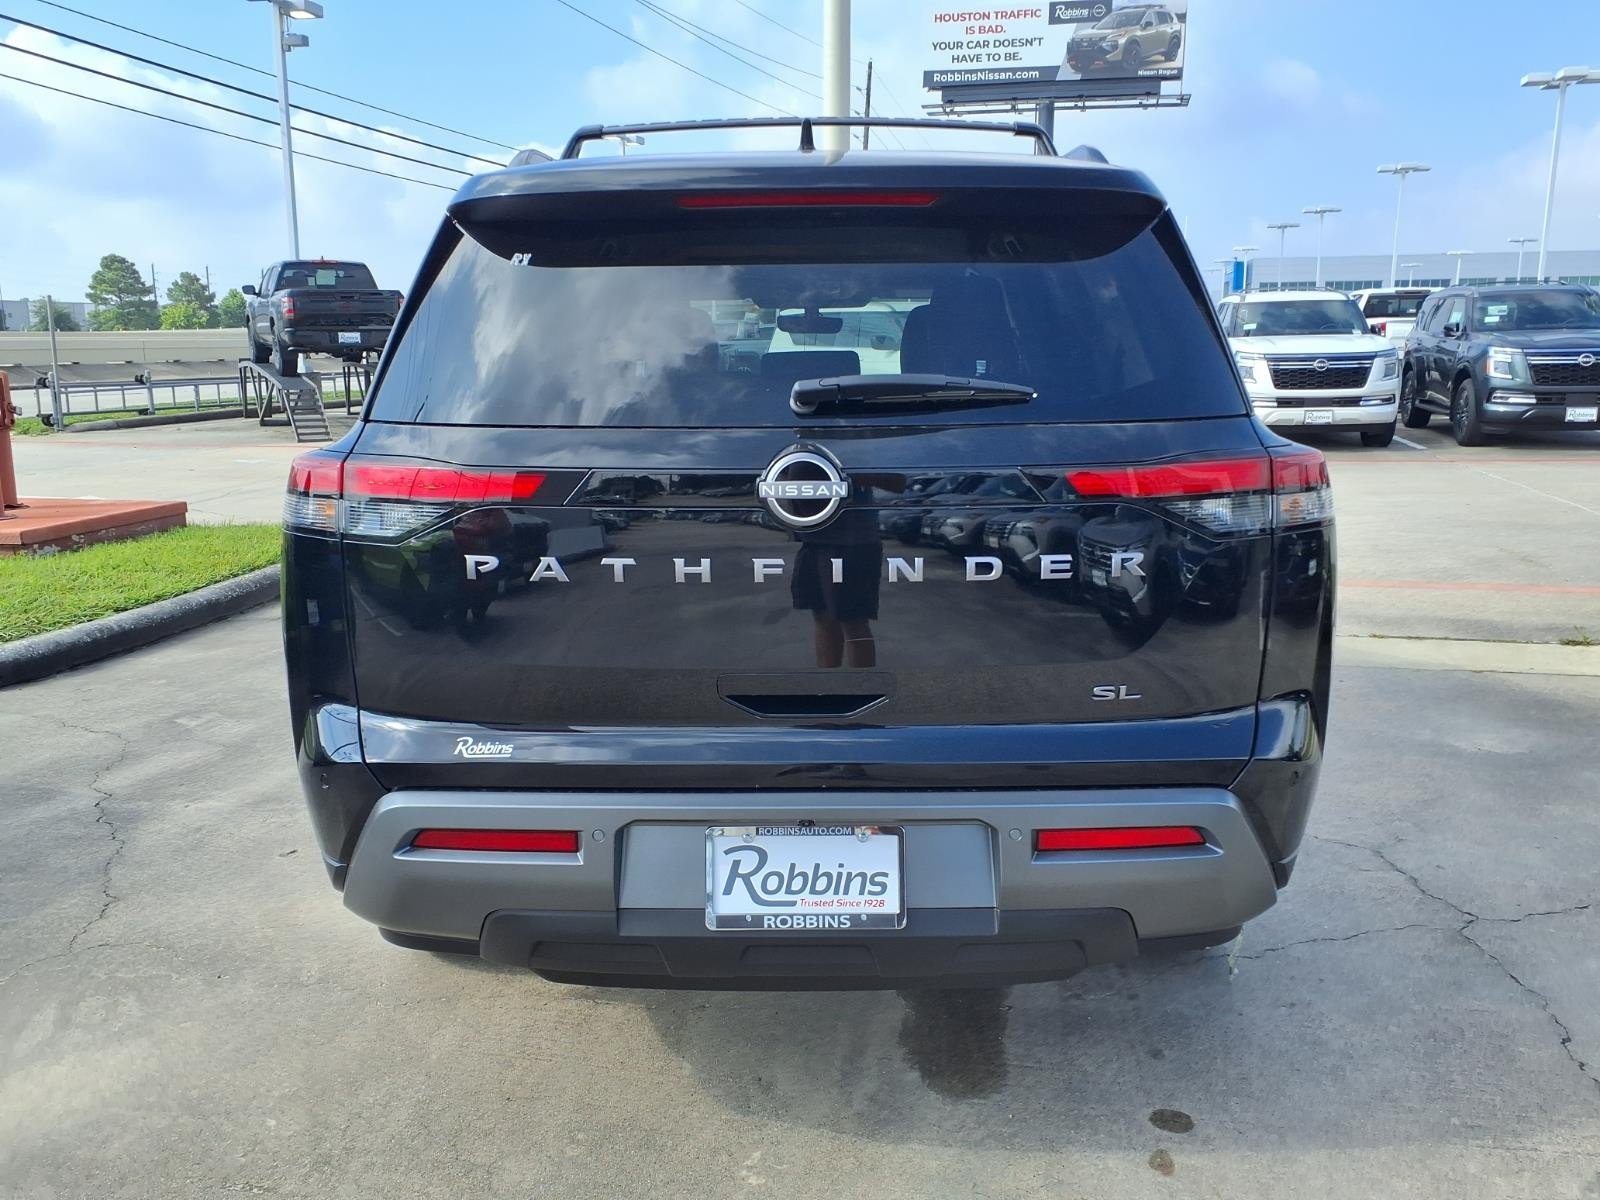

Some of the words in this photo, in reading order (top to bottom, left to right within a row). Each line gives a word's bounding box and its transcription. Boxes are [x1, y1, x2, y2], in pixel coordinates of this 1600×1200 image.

[934, 11, 991, 23] HOUSTON
[993, 8, 1042, 20] TRAFFIC
[1054, 4, 1089, 19] Robbins
[965, 26, 976, 35] IS
[978, 25, 1006, 34] BAD.
[932, 41, 964, 51] YOUR
[966, 39, 990, 50] CAR
[993, 37, 1044, 49] DOESN'T
[951, 53, 983, 63] HAVE
[985, 53, 1001, 62] TO
[1004, 52, 1023, 61] BE.
[933, 70, 1040, 82] RobbinsNissan.com
[762, 484, 847, 497] NISSAN
[463, 551, 1146, 583] PATHFINDER
[1091, 685, 1142, 701] SL
[453, 736, 514, 759] Robbins
[758, 826, 852, 836] ROBBINSAUTO.COM
[722, 844, 889, 907] Robbins
[799, 898, 834, 908] Trusted
[836, 898, 862, 908] Since
[863, 898, 885, 908] 1928
[763, 915, 851, 929] ROBBINS
